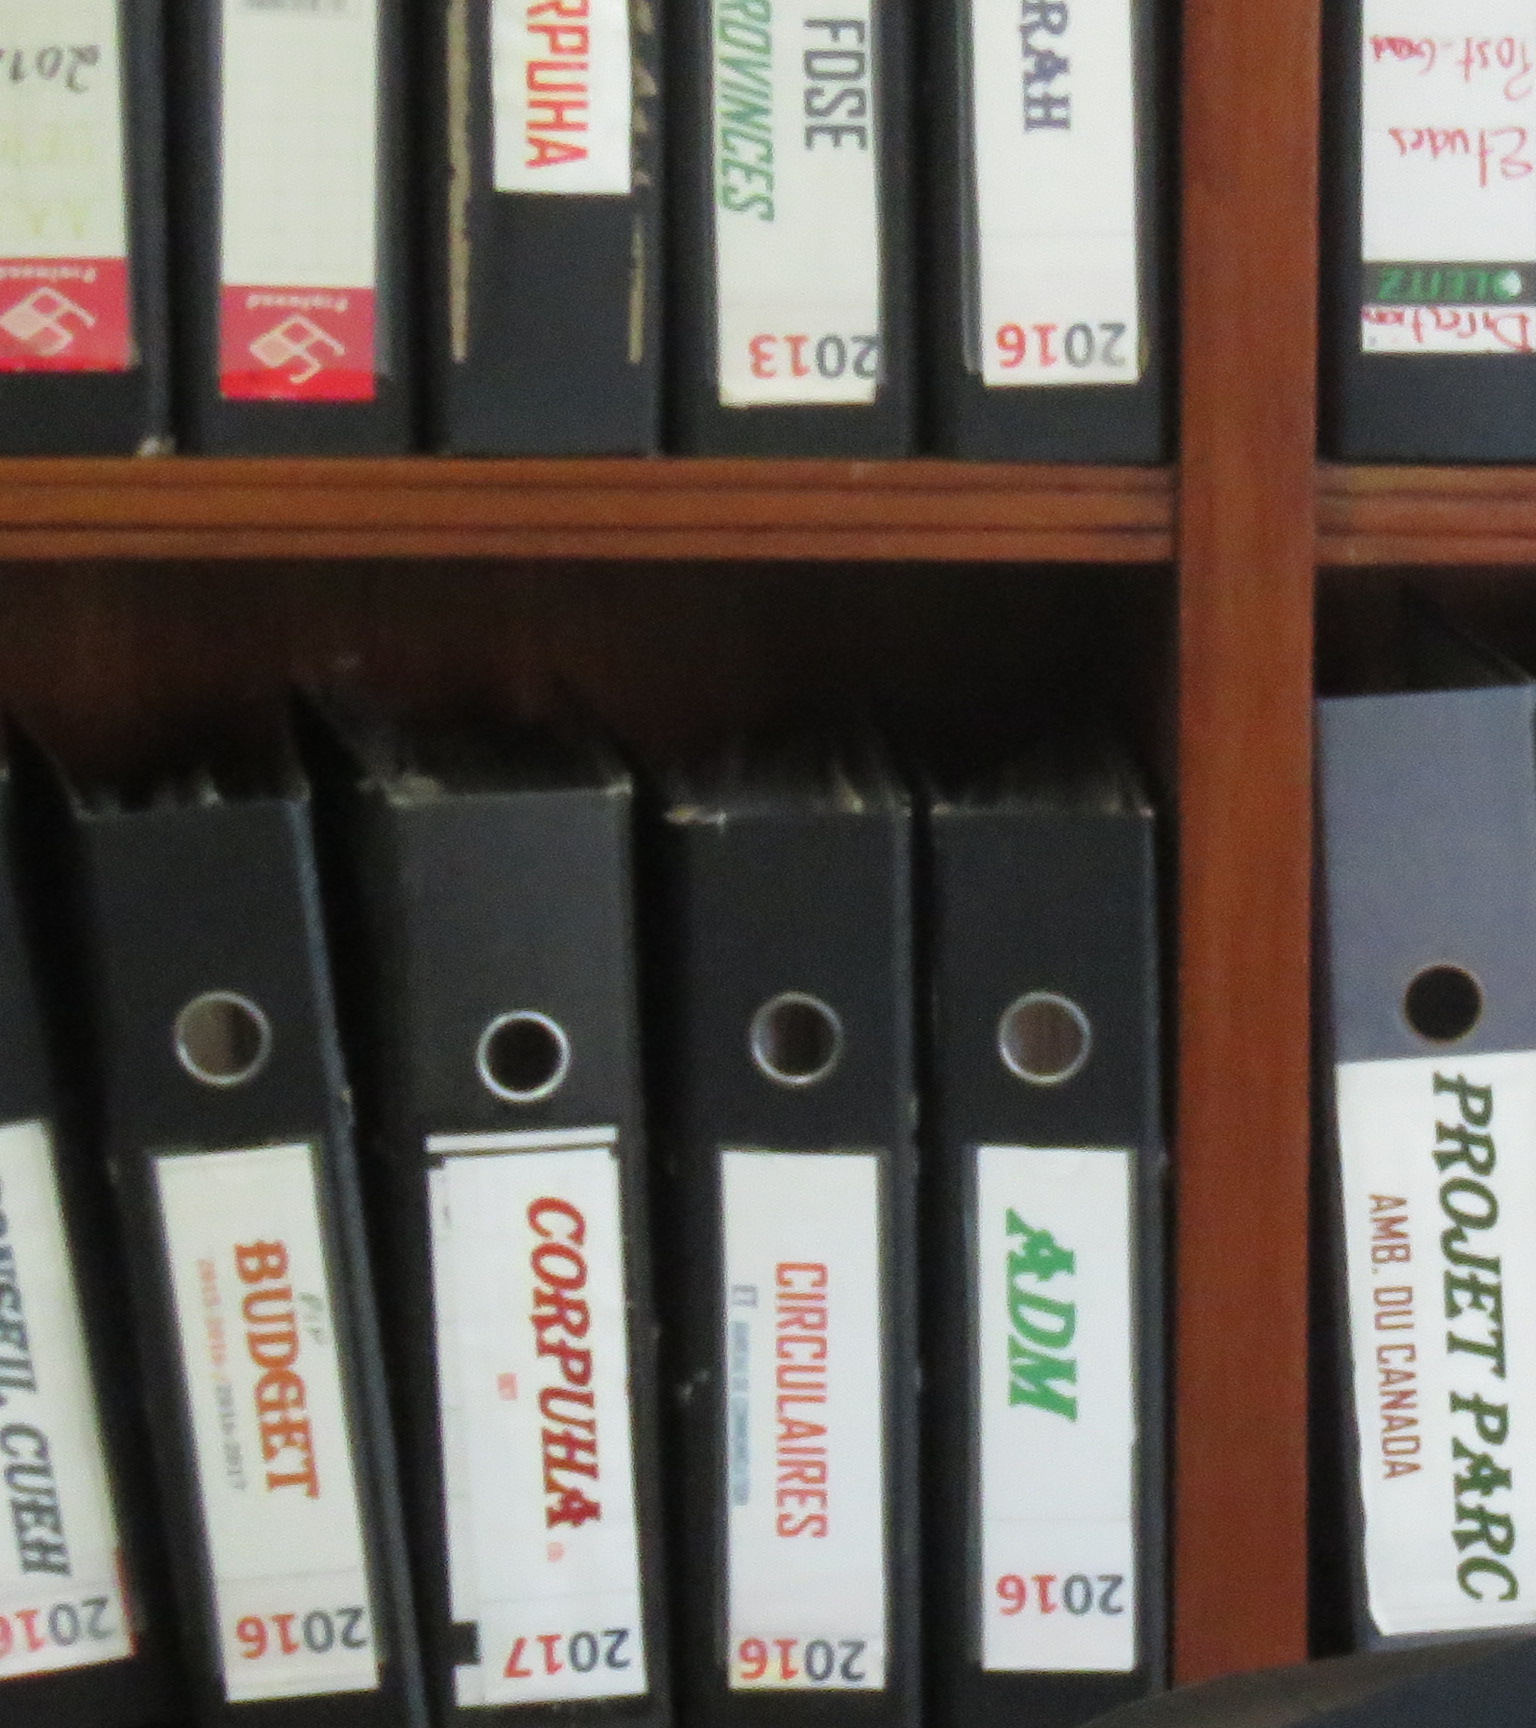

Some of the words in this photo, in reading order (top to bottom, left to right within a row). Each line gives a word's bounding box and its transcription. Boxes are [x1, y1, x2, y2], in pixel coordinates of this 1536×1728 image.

[0, 43, 100, 93] 201
[747, 334, 880, 380] 2013
[994, 322, 1127, 368] 2016
[1368, 1192, 1410, 1276] AMB.
[1432, 1070, 1508, 1382] PROJET
[1004, 1206, 1079, 1424] ADM
[1373, 1284, 1416, 1333] DU
[233, 1238, 319, 1499] BUDGET
[525, 1196, 601, 1529] CORPUHA
[775, 1262, 829, 1539] CIRCULAIRES
[1375, 1343, 1424, 1482] CANADA
[2, 1423, 71, 1576] CUEH
[1449, 1390, 1520, 1604] PARC
[235, 1606, 368, 1660] 2016
[996, 1573, 1124, 1616] 2016
[502, 1628, 632, 1678] 2017
[738, 1637, 867, 1682] 2016
